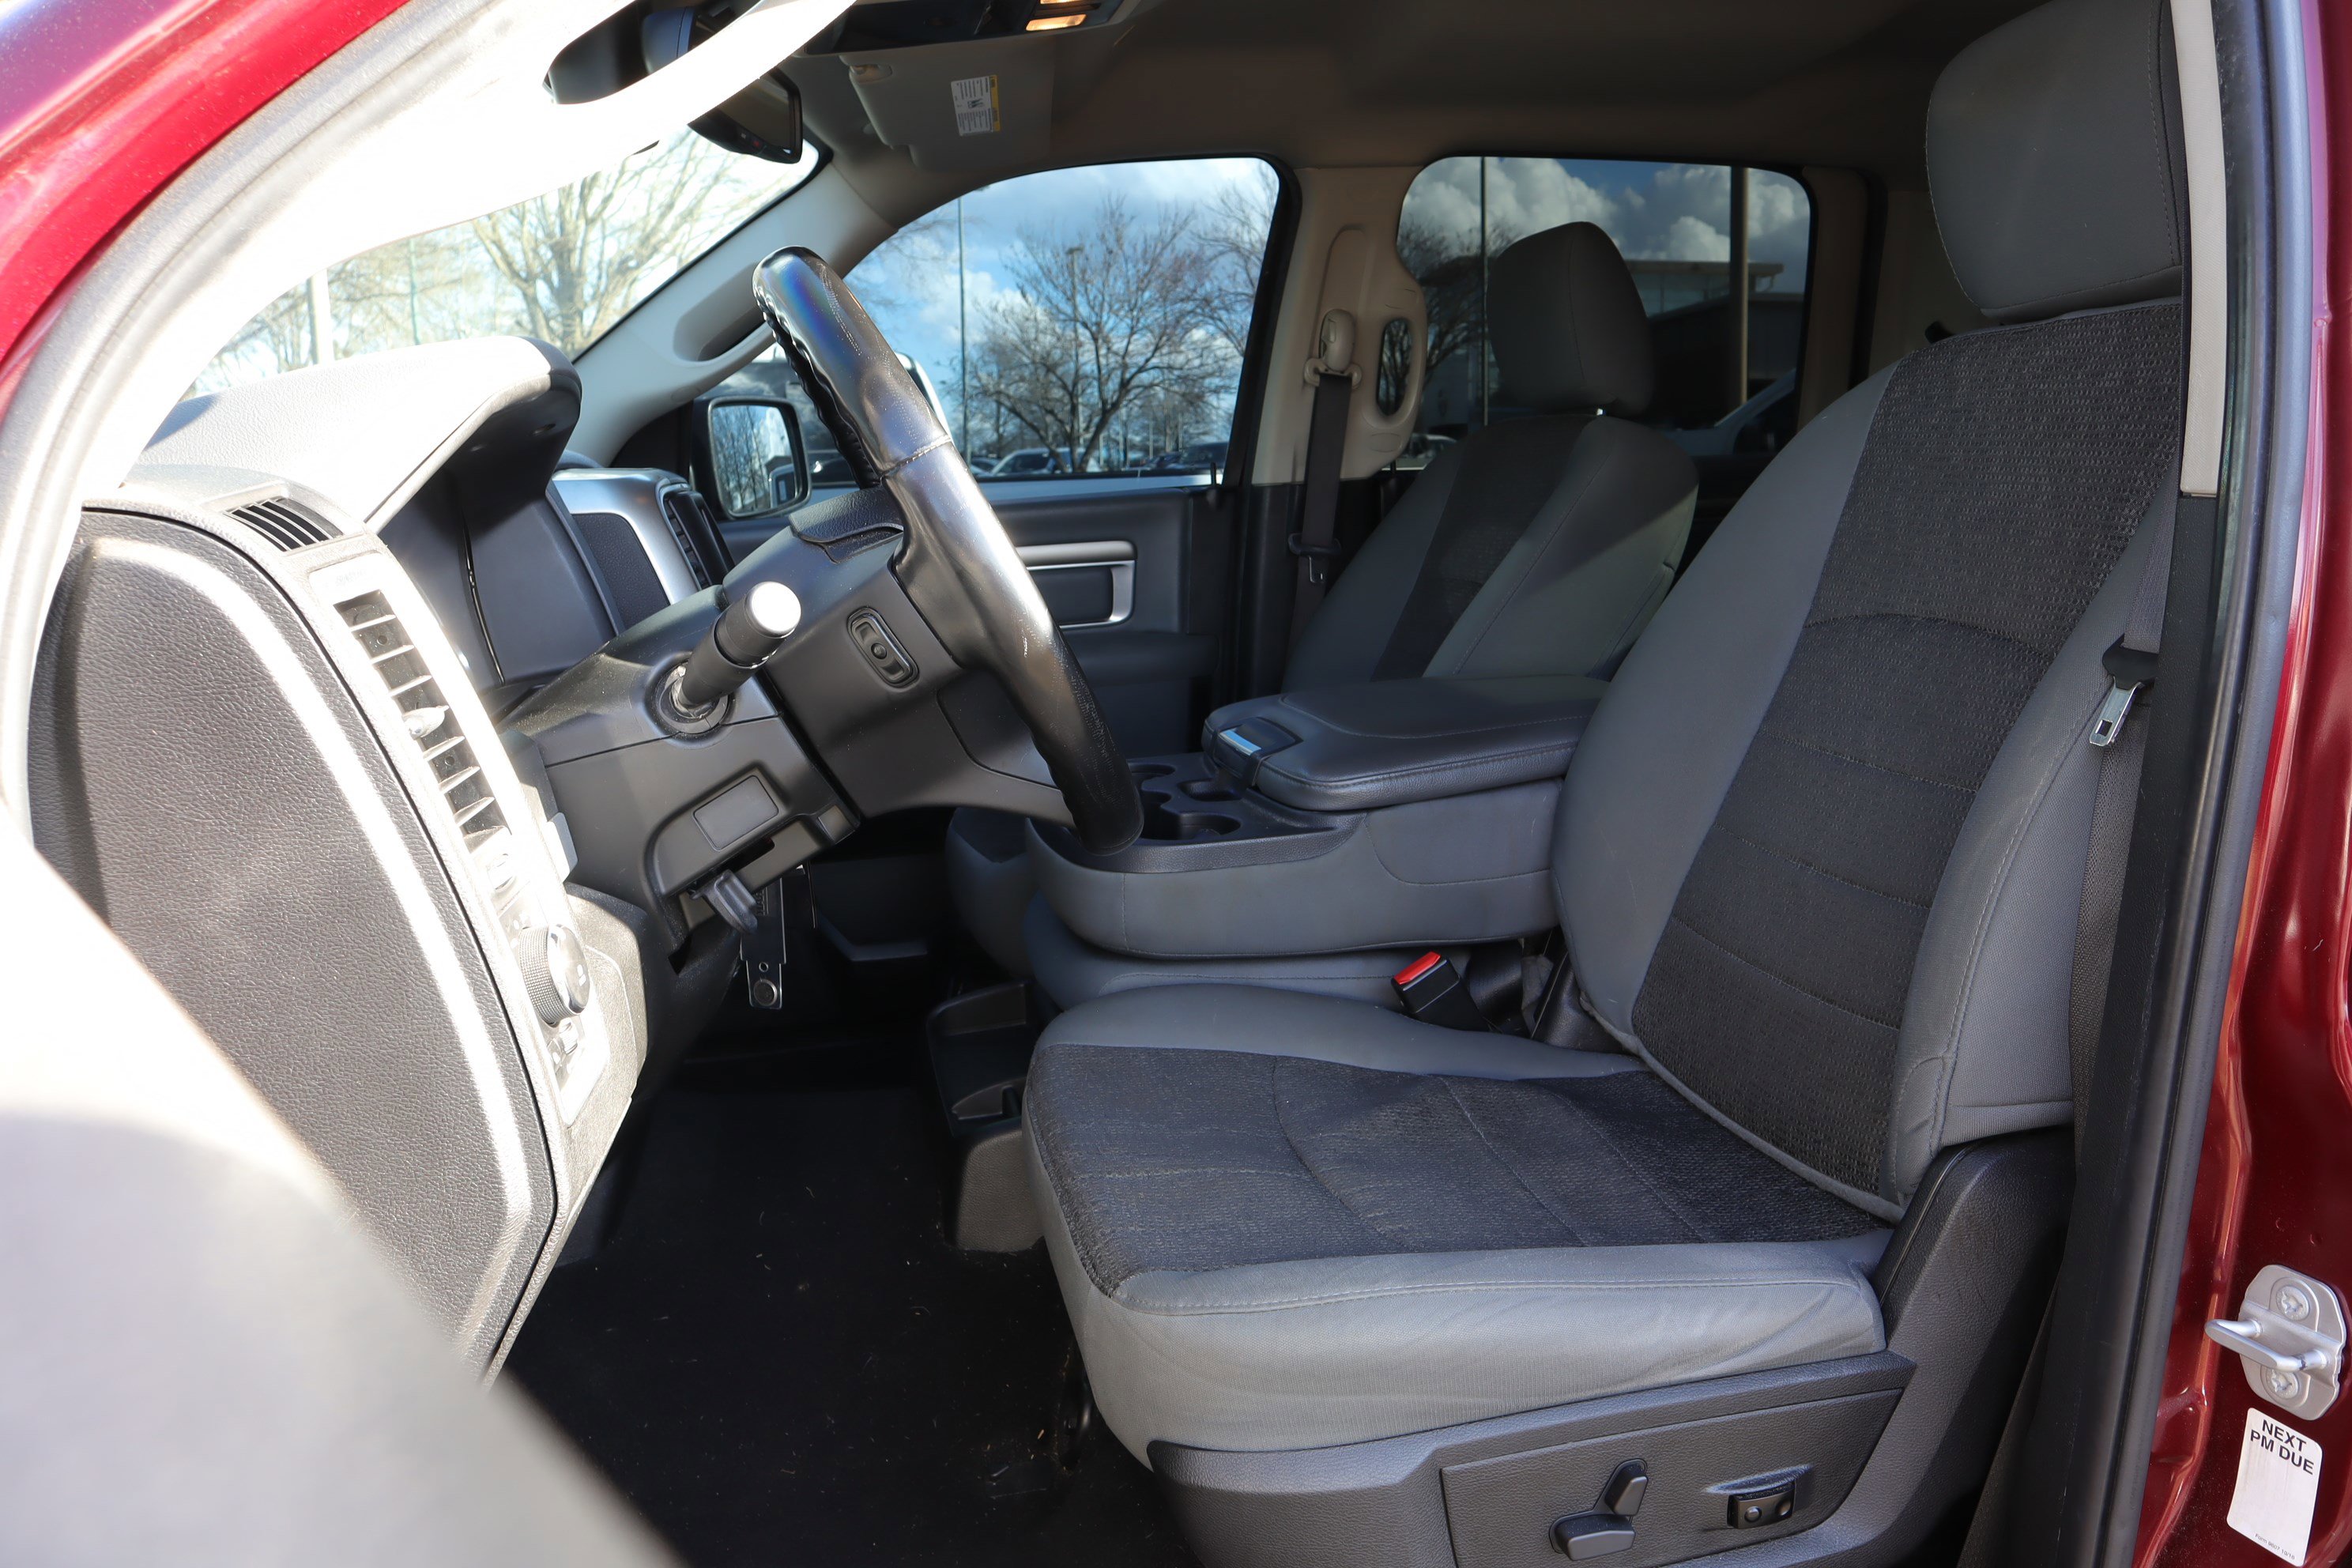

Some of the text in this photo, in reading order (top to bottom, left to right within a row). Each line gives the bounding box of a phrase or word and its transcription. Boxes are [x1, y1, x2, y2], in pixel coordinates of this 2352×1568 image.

[2262, 1419, 2307, 1452] NEXT
[2250, 1429, 2314, 1476] PM DUE
[2255, 1532, 2267, 1544] Form
